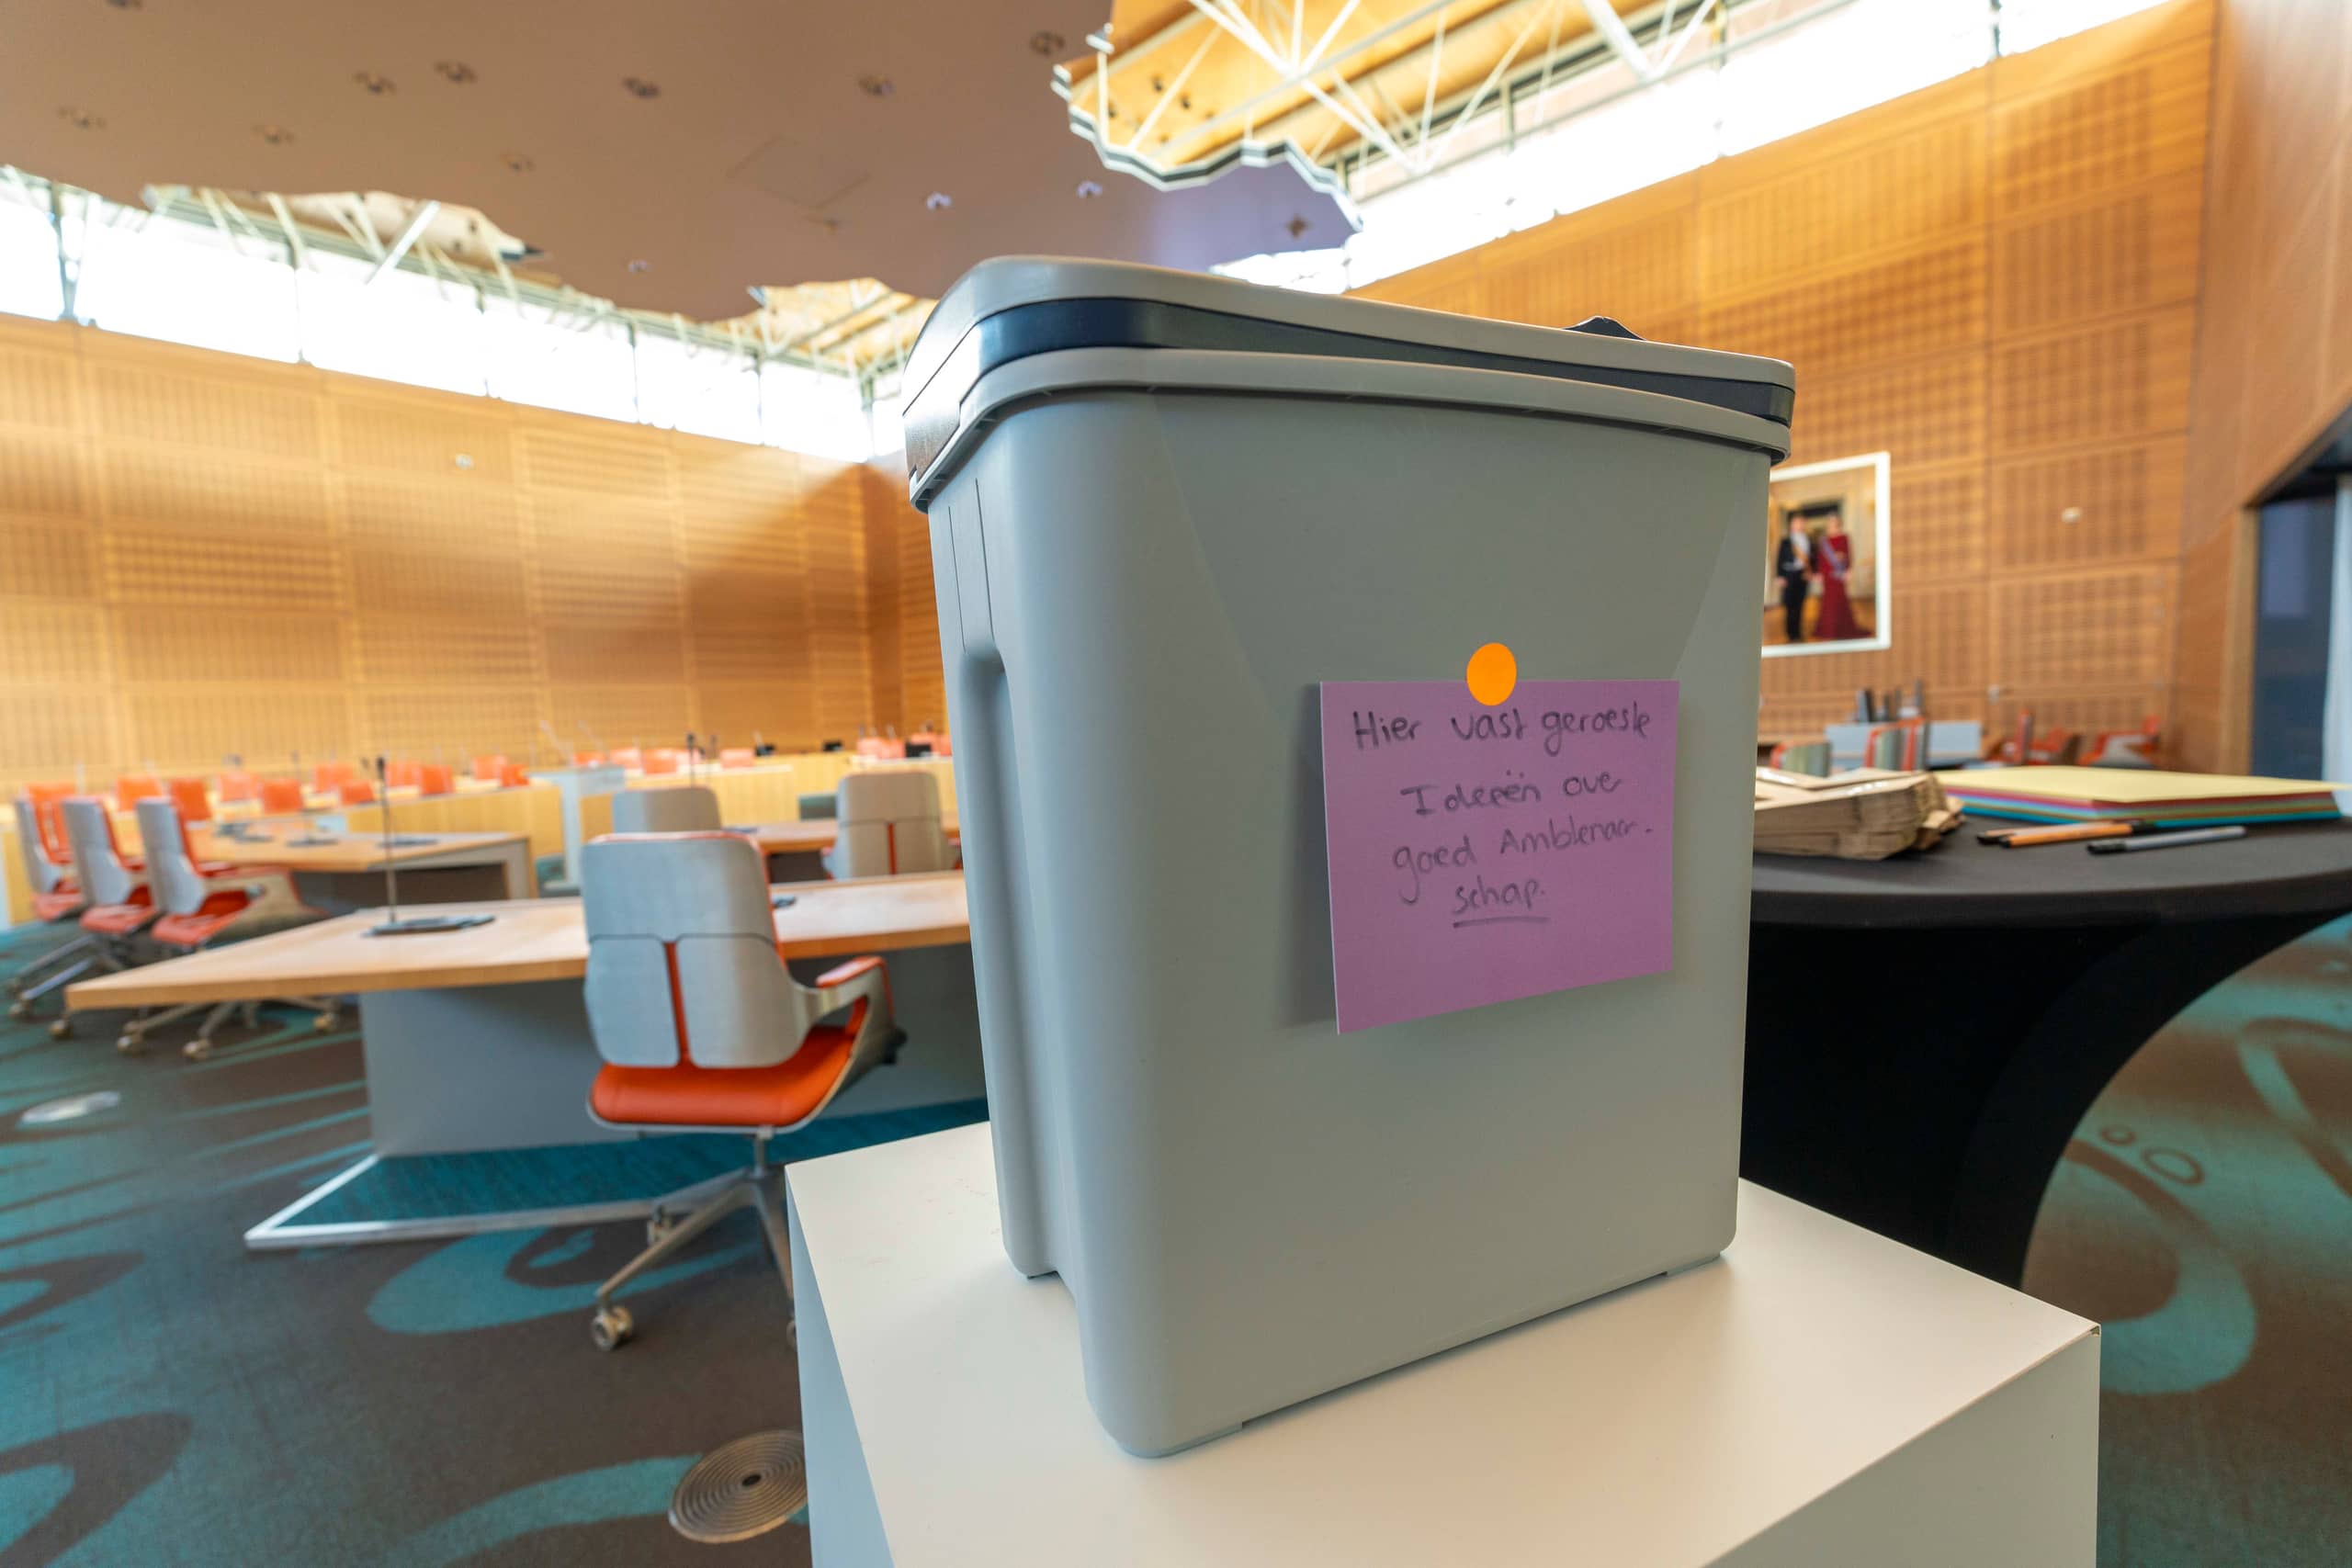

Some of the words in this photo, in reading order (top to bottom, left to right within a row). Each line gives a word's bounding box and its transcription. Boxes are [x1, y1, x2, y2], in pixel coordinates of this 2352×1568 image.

[1352, 711, 1422, 750] Hier
[1450, 708, 1528, 741] vast
[1392, 834, 1477, 906] goed
